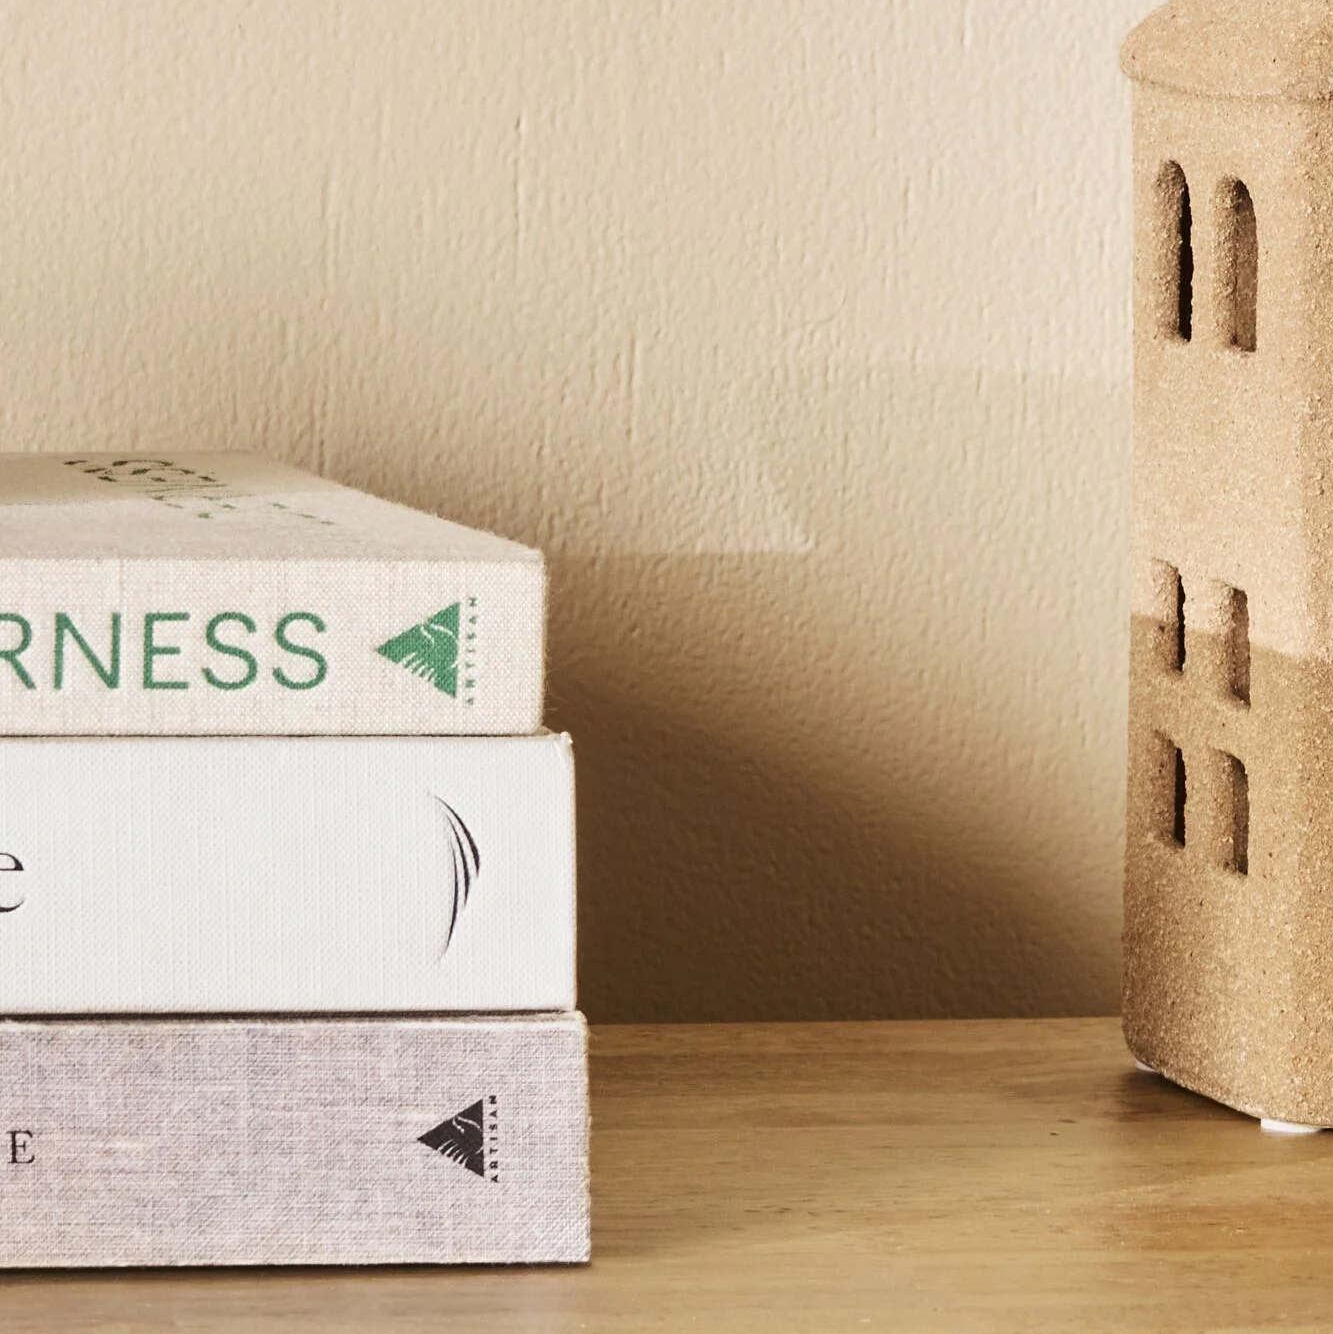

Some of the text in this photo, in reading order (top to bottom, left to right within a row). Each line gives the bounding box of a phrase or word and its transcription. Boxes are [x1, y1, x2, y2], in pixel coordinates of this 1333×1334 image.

[0, 611, 328, 691] RNESS
[465, 596, 478, 707] ARTISAN
[7, 1129, 36, 1165] E
[488, 1094, 500, 1184] ARTISAN
